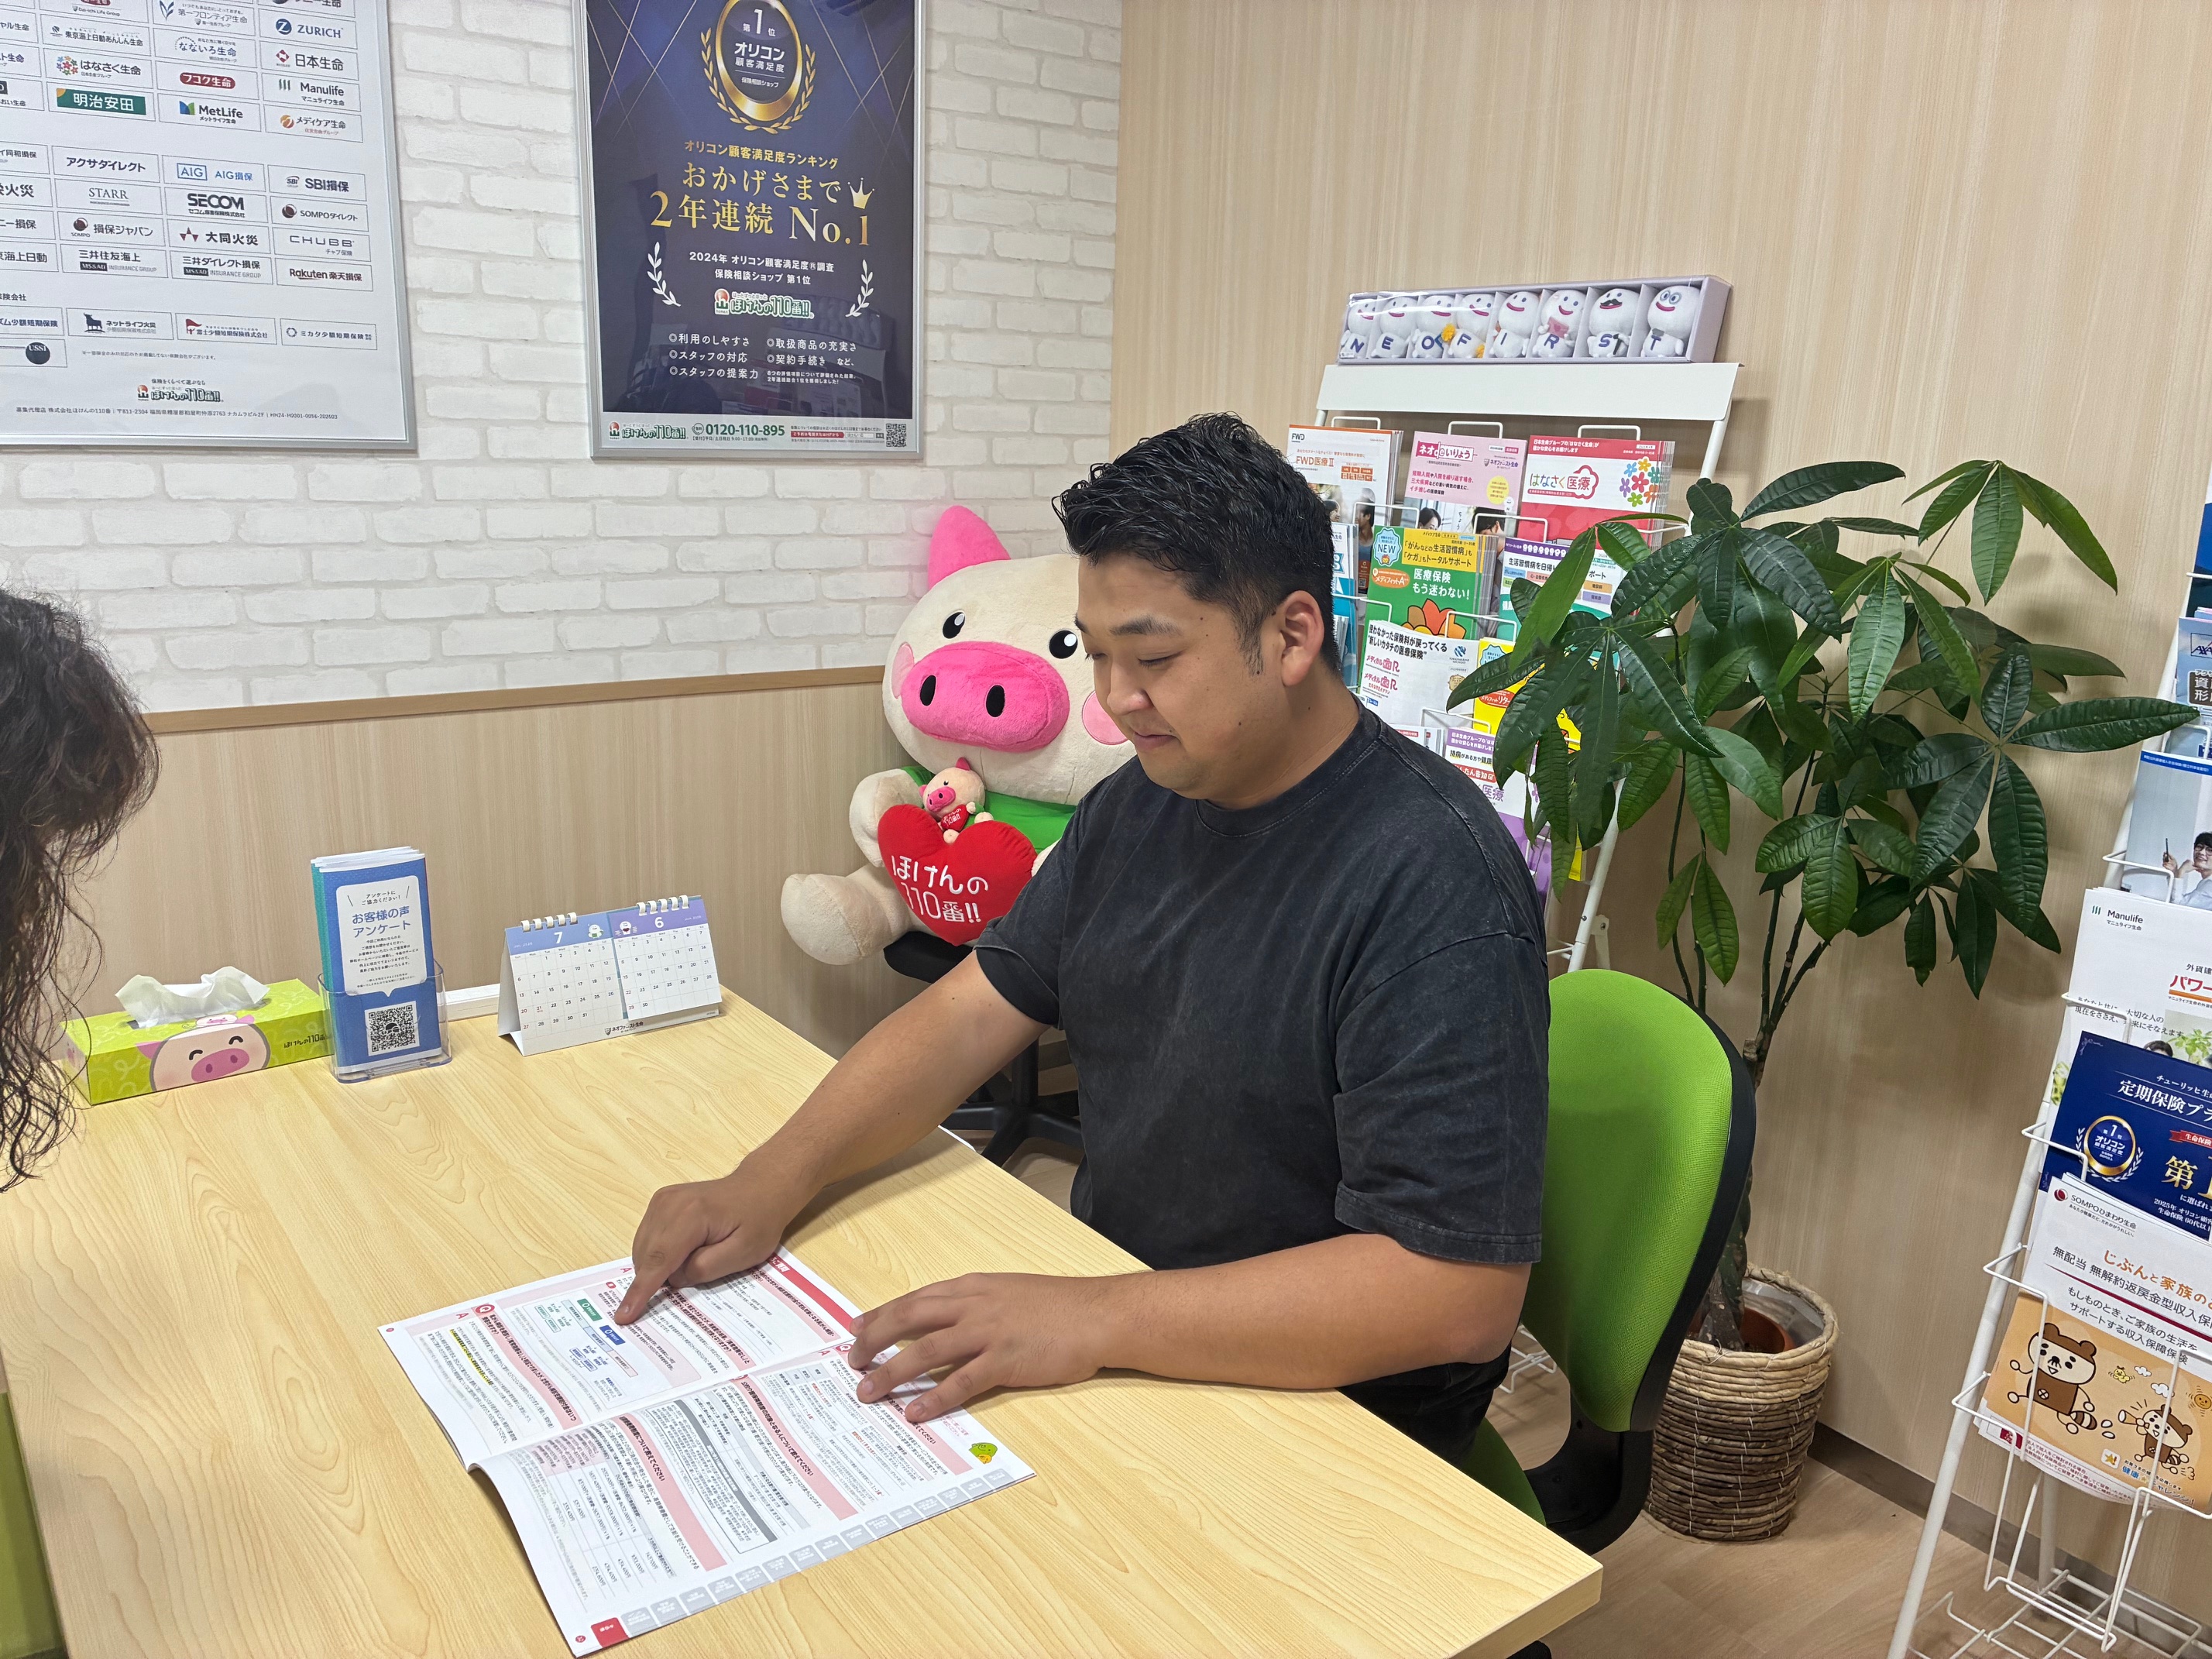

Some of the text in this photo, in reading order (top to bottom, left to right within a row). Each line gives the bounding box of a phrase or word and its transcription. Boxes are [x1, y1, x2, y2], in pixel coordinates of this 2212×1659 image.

[178, 9, 247, 23] 第一フロンティア生命
[65, 31, 143, 46] 東京海上日動あんしん生命
[297, 25, 341, 38] ZURICH
[179, 42, 236, 57] なないろ生命
[734, 42, 785, 61] オリコン
[0, 53, 24, 63] ト生命
[296, 54, 344, 71] 日本生命
[735, 57, 785, 74] 顧客満足度
[81, 60, 142, 75] はなさく生命
[183, 74, 231, 88] フコク生命
[301, 82, 344, 96] Manulife
[74, 93, 134, 112] 明治安田
[301, 96, 345, 106] マニュライフ生命
[199, 105, 243, 118] MetLife
[297, 117, 345, 129] メディケア生命
[685, 140, 838, 170] オリコン顧客満足度ランキング
[67, 157, 146, 173] アクサダイレクト
[181, 167, 252, 181] AIG AIG損保
[305, 179, 349, 192] SBI損保
[682, 162, 841, 203] おかげさまで
[89, 188, 129, 200] STARR
[187, 194, 244, 210] SECOM
[300, 210, 358, 222] SOMPOダイレクト
[650, 191, 869, 246] 2年連続 No.1
[94, 224, 153, 237] 損保ジャパン
[206, 232, 259, 246] 大同火災
[289, 235, 352, 247] CHUBB
[79, 250, 141, 263] 三井住友海上
[183, 256, 260, 269] 三井ダイレクト損保
[689, 251, 727, 263] 2024年
[290, 269, 362, 282] Rakuten 楽天損保
[715, 269, 811, 284] 保険相談ショップ 第1位
[706, 424, 785, 437] 0120-110-895
[1530, 473, 1590, 490] はなさく医療
[1378, 544, 1396, 554] NEW
[1405, 541, 1472, 556] 「がんなどの生活習慣病」も
[1404, 552, 1472, 567] 「ケガ」もトータルサポート
[1414, 568, 1451, 583] 医療保険
[1413, 582, 1470, 600] もう迷わない!
[1369, 624, 1447, 652] 使わなかった保険料が戻ってくる
[891, 855, 989, 895] ほけんの
[352, 906, 410, 924] お客様の声
[654, 917, 664, 928] 6
[2107, 909, 2144, 924] Manulife
[353, 920, 410, 938] アンケート
[2107, 919, 2142, 931] マニュライフ生命
[554, 932, 563, 943] 7
[2124, 1018, 2183, 1037] 来にそなえます
[2095, 1135, 2125, 1150] オリコン
[2071, 1194, 2136, 1229] SOMPOひまわり生命
[2154, 1198, 2176, 1211] 2025年
[2158, 1207, 2183, 1222] 生命保険
[2052, 1246, 2087, 1271] 無配当
[2068, 1287, 2197, 1352] もしものとき、ご家族の生活を
